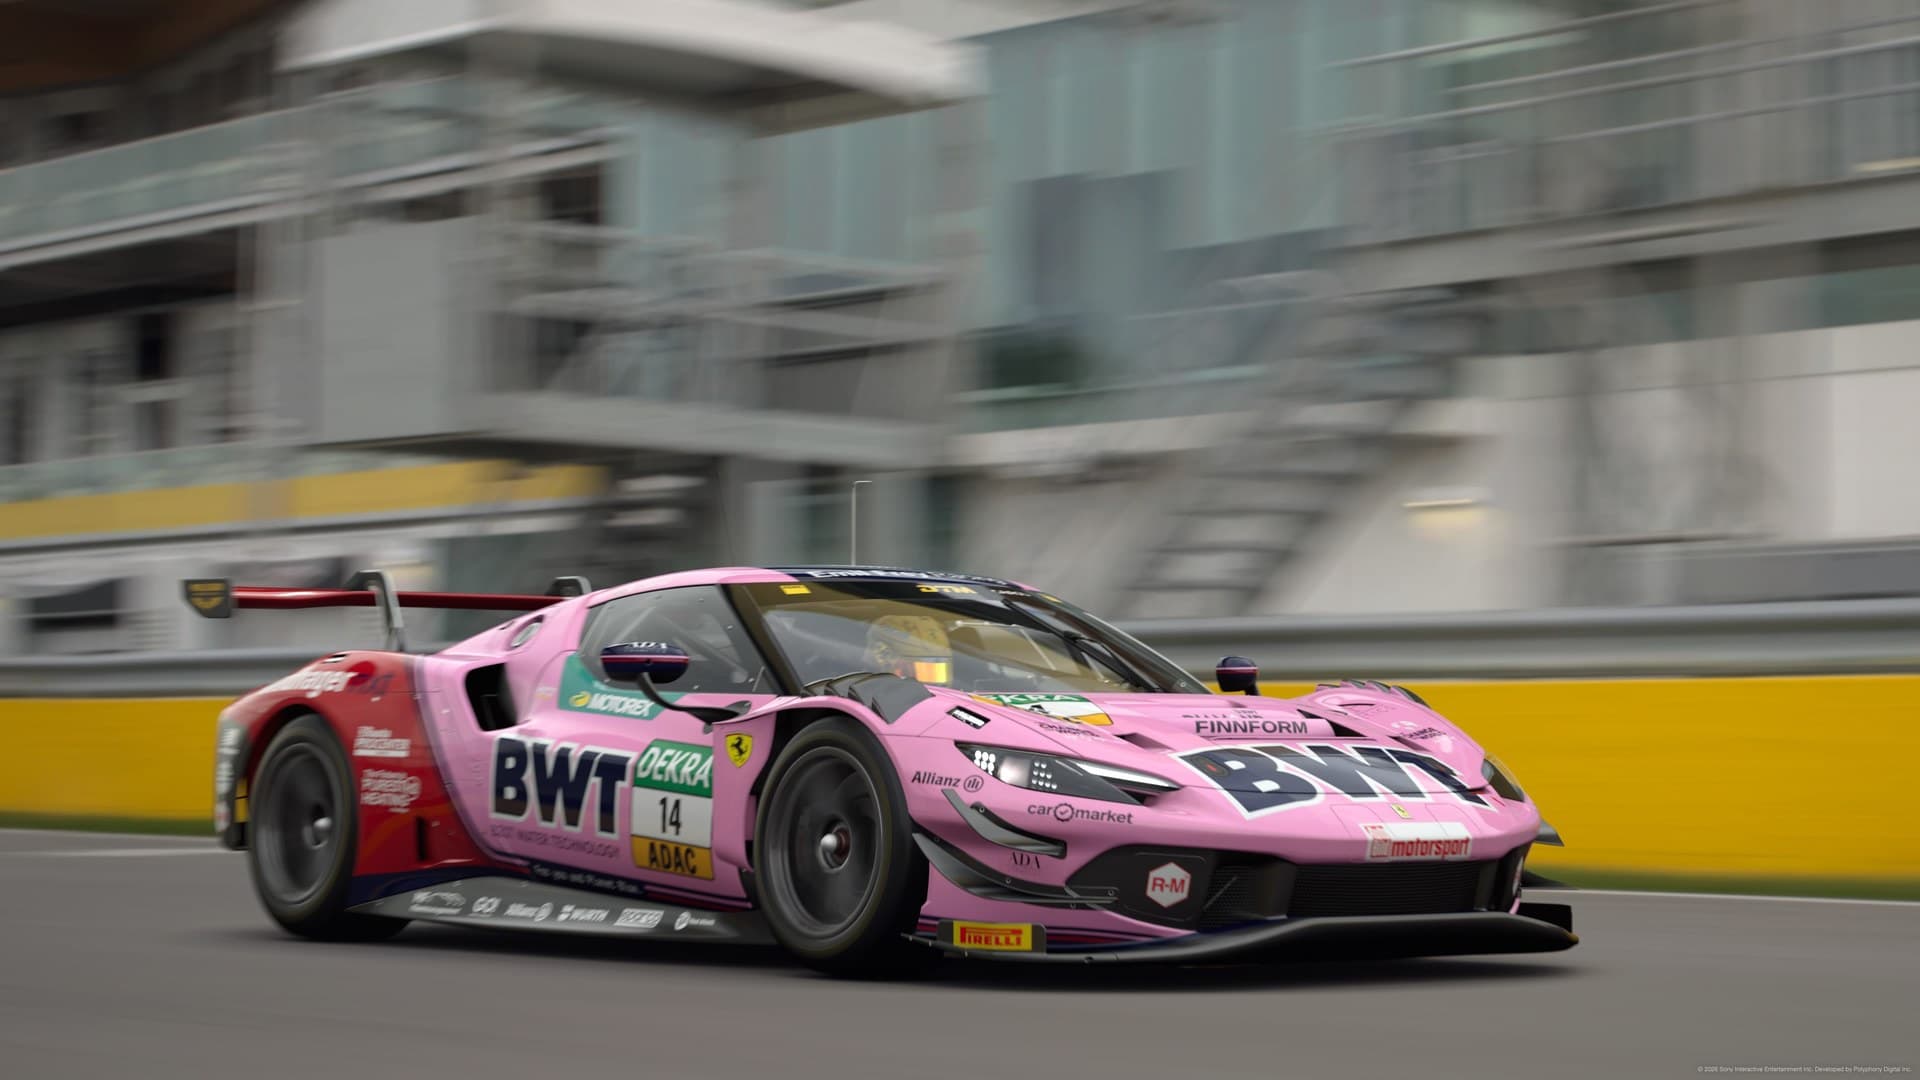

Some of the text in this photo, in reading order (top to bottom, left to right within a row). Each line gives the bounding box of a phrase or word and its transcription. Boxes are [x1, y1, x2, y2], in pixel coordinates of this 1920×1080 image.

[587, 693, 655, 717] MOTOREX
[1195, 720, 1308, 734] FINNFORM
[637, 747, 713, 788] DEKRA
[911, 771, 961, 788] Allianz
[491, 735, 638, 840] BWT
[1178, 741, 1498, 820] BWT
[660, 796, 682, 836] 14
[648, 842, 697, 874] ADAC
[1391, 837, 1471, 860] motorsport
[1151, 877, 1185, 893] R-M
[960, 927, 1023, 946] PIRELLI
